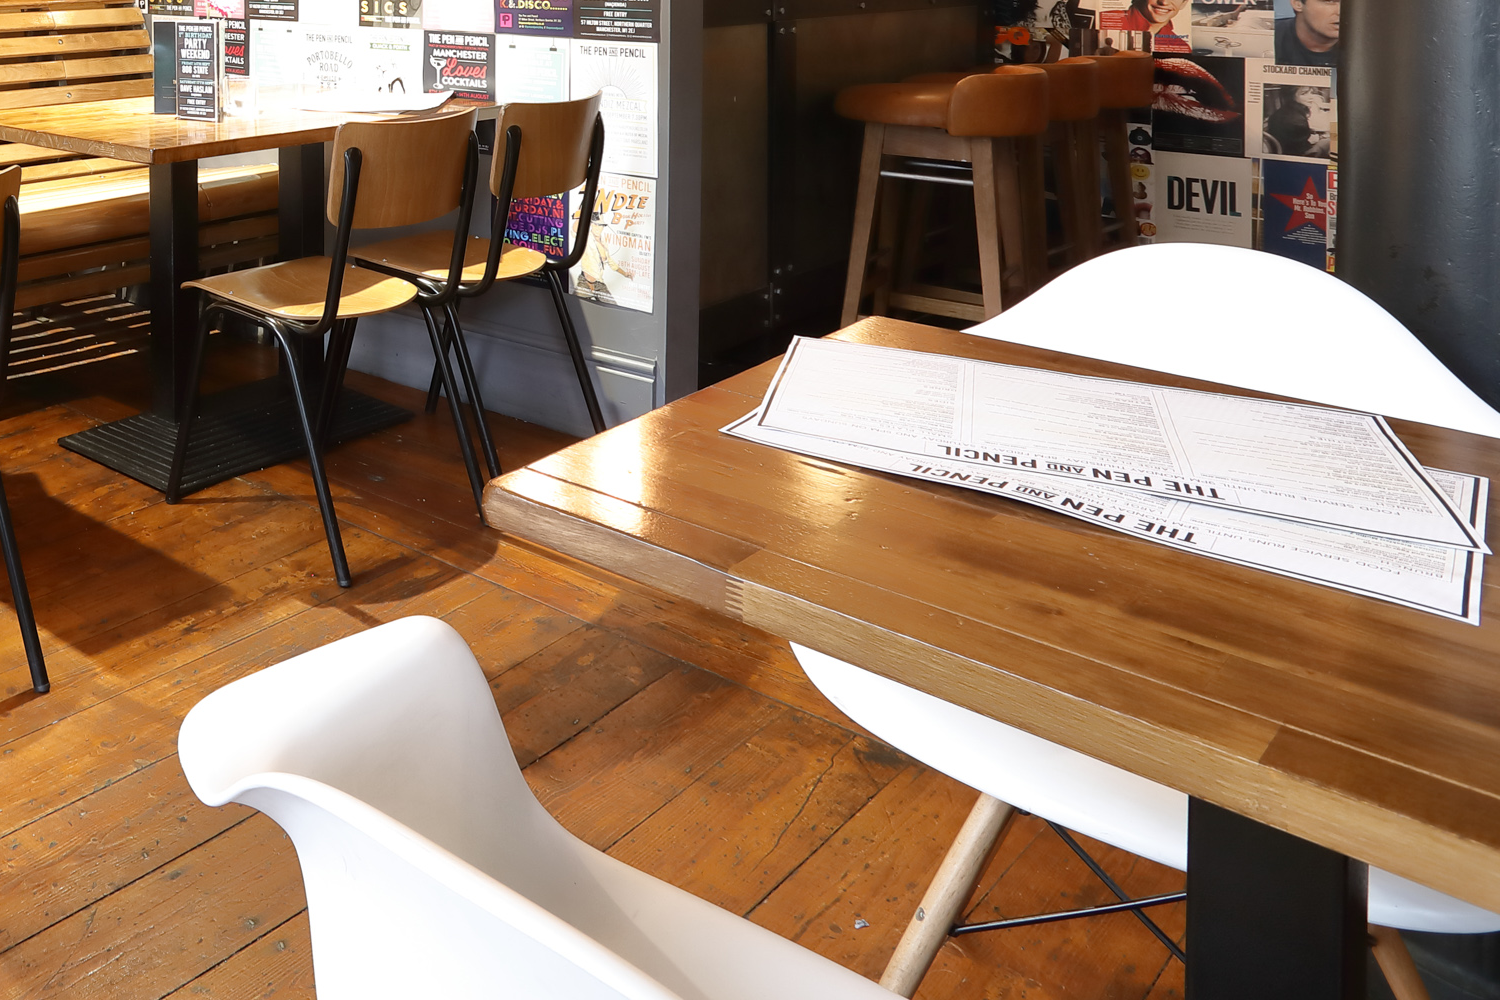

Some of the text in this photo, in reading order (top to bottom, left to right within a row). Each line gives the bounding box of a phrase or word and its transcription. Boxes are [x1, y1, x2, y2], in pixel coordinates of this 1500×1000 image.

[360, 1, 408, 14] SICS
[228, 21, 246, 30] PENCIL
[184, 38, 207, 49] PARTY
[306, 34, 353, 44] THE PEN PENCIL
[428, 33, 489, 47] THE PEN PENCIL
[181, 49, 210, 59] WEEKEND
[433, 49, 487, 60] MANCHESTER
[580, 46, 646, 58] THE PEN PENCIL
[306, 50, 353, 69] PORTOBELLO
[193, 66, 208, 75] STATE
[319, 62, 339, 73] ROAD
[442, 58, 487, 79] Loves
[1262, 64, 1297, 75] STOCKARD
[441, 77, 487, 88] COCKTAILS
[616, 100, 642, 111] MEZCAL
[621, 178, 652, 193] PENCIL
[1167, 175, 1242, 218] DEVIL
[1293, 198, 1309, 206] Here's
[604, 232, 651, 252] WINGMAN
[937, 444, 1226, 501] THE PEN AND PENCIL
[909, 462, 1198, 546] THE PEN AND PENCIL
[1262, 489, 1401, 516] FOOD SERVICE RUNS
[1249, 538, 1401, 575] FOOD SERVICE RUNS
